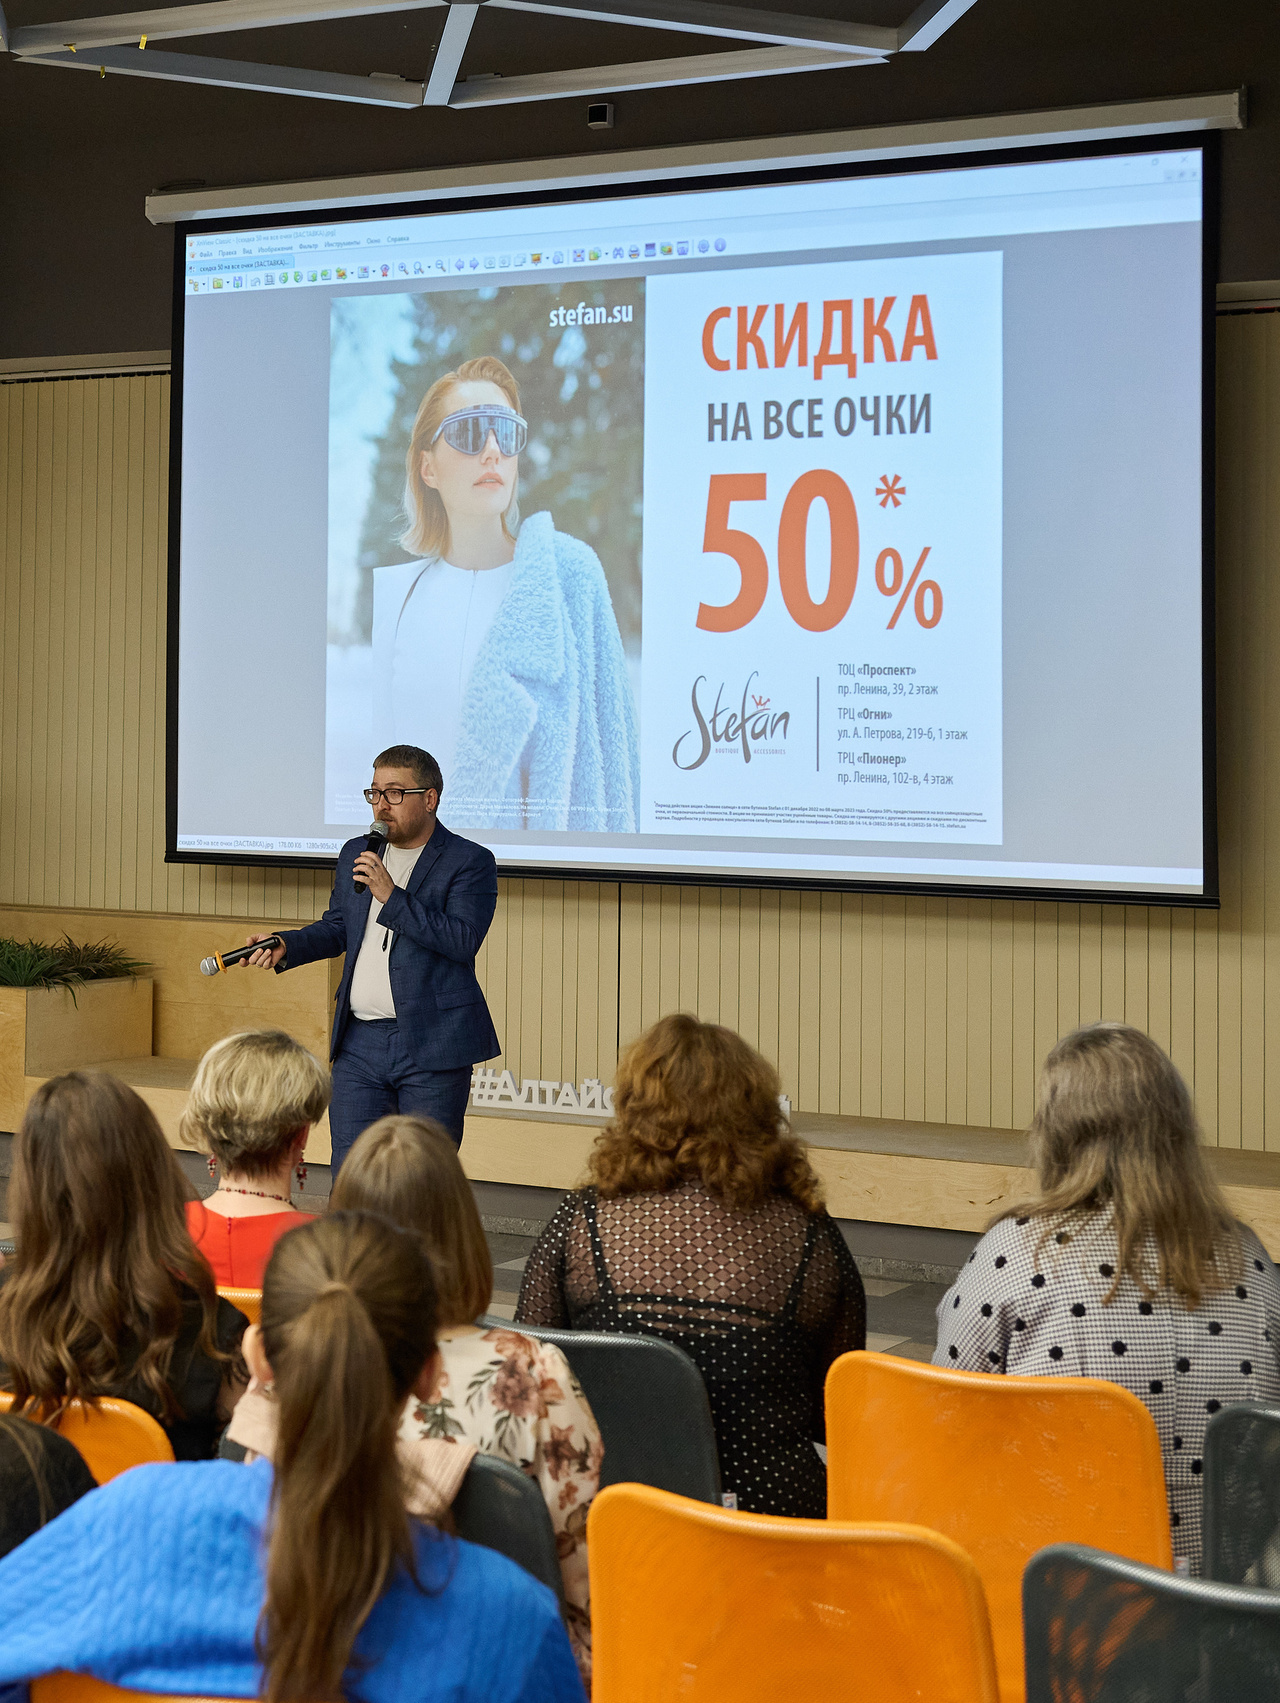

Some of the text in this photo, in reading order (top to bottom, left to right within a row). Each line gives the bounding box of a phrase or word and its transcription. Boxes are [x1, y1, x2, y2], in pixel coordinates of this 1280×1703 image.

[549, 302, 634, 329] stefan.su
[701, 294, 939, 381] СКИДКА
[708, 393, 932, 442] НА ВСЕ ОЧКИ
[838, 663, 917, 678] ТОЦ «Проспект»
[838, 682, 939, 697] пр. Ленина, 39, 2 этаж
[672, 670, 790, 771] Stefan
[838, 707, 893, 721] ТРЦ «Огни»
[837, 729, 851, 741] ул.
[852, 726, 862, 739] А.
[864, 726, 905, 741] Петрова,
[938, 728, 943, 740] 1
[945, 730, 968, 740] этаж
[838, 751, 907, 767] ТРЦ «Пионер»
[837, 771, 954, 785] пр. Ленина, 102-в, 4 этаж
